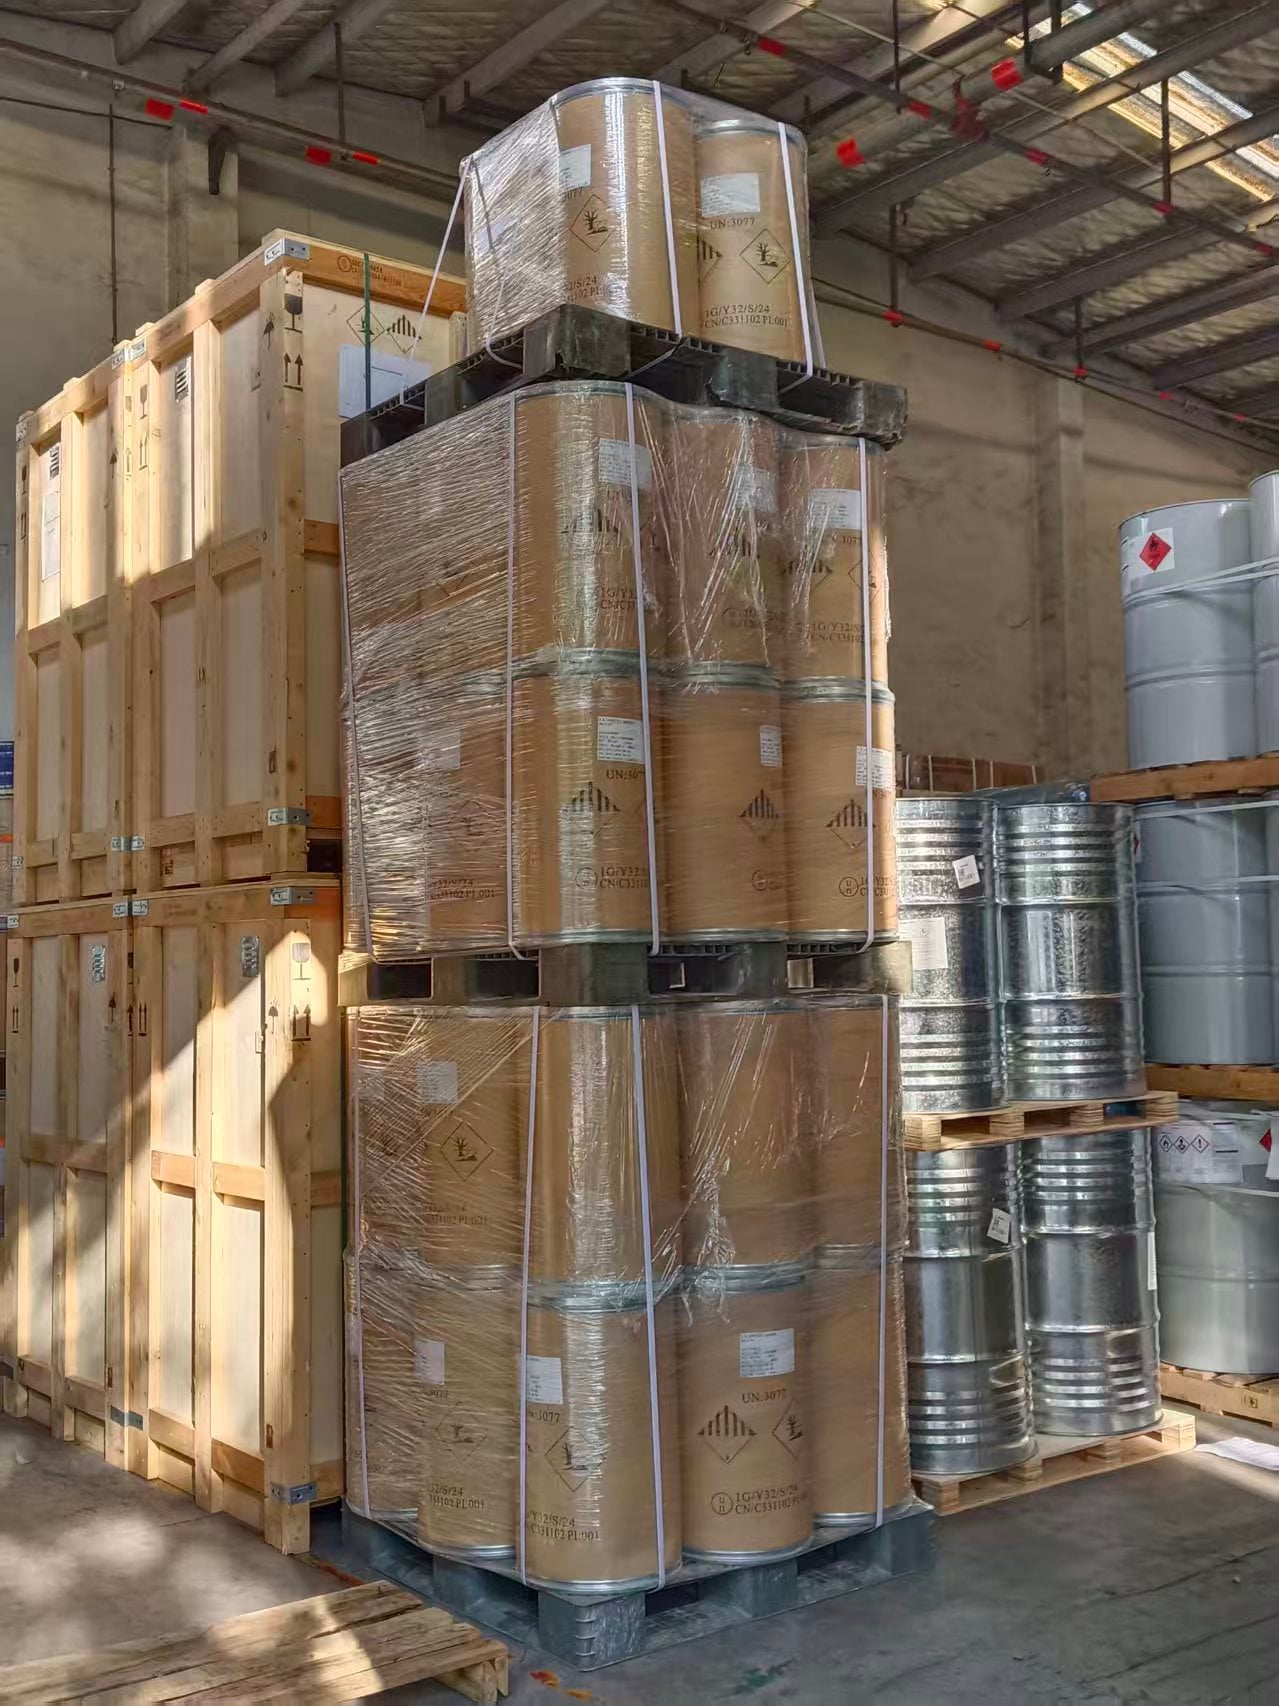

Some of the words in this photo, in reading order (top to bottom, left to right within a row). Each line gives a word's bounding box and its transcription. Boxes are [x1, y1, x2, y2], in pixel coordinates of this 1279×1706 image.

[710, 217, 755, 229] UN:3077
[705, 304, 770, 318] 1G/Y32/S/24
[704, 315, 761, 329] CN/C331102
[742, 1389, 786, 1403] UN:3077
[736, 1484, 798, 1503] 1G/Y32/S/24
